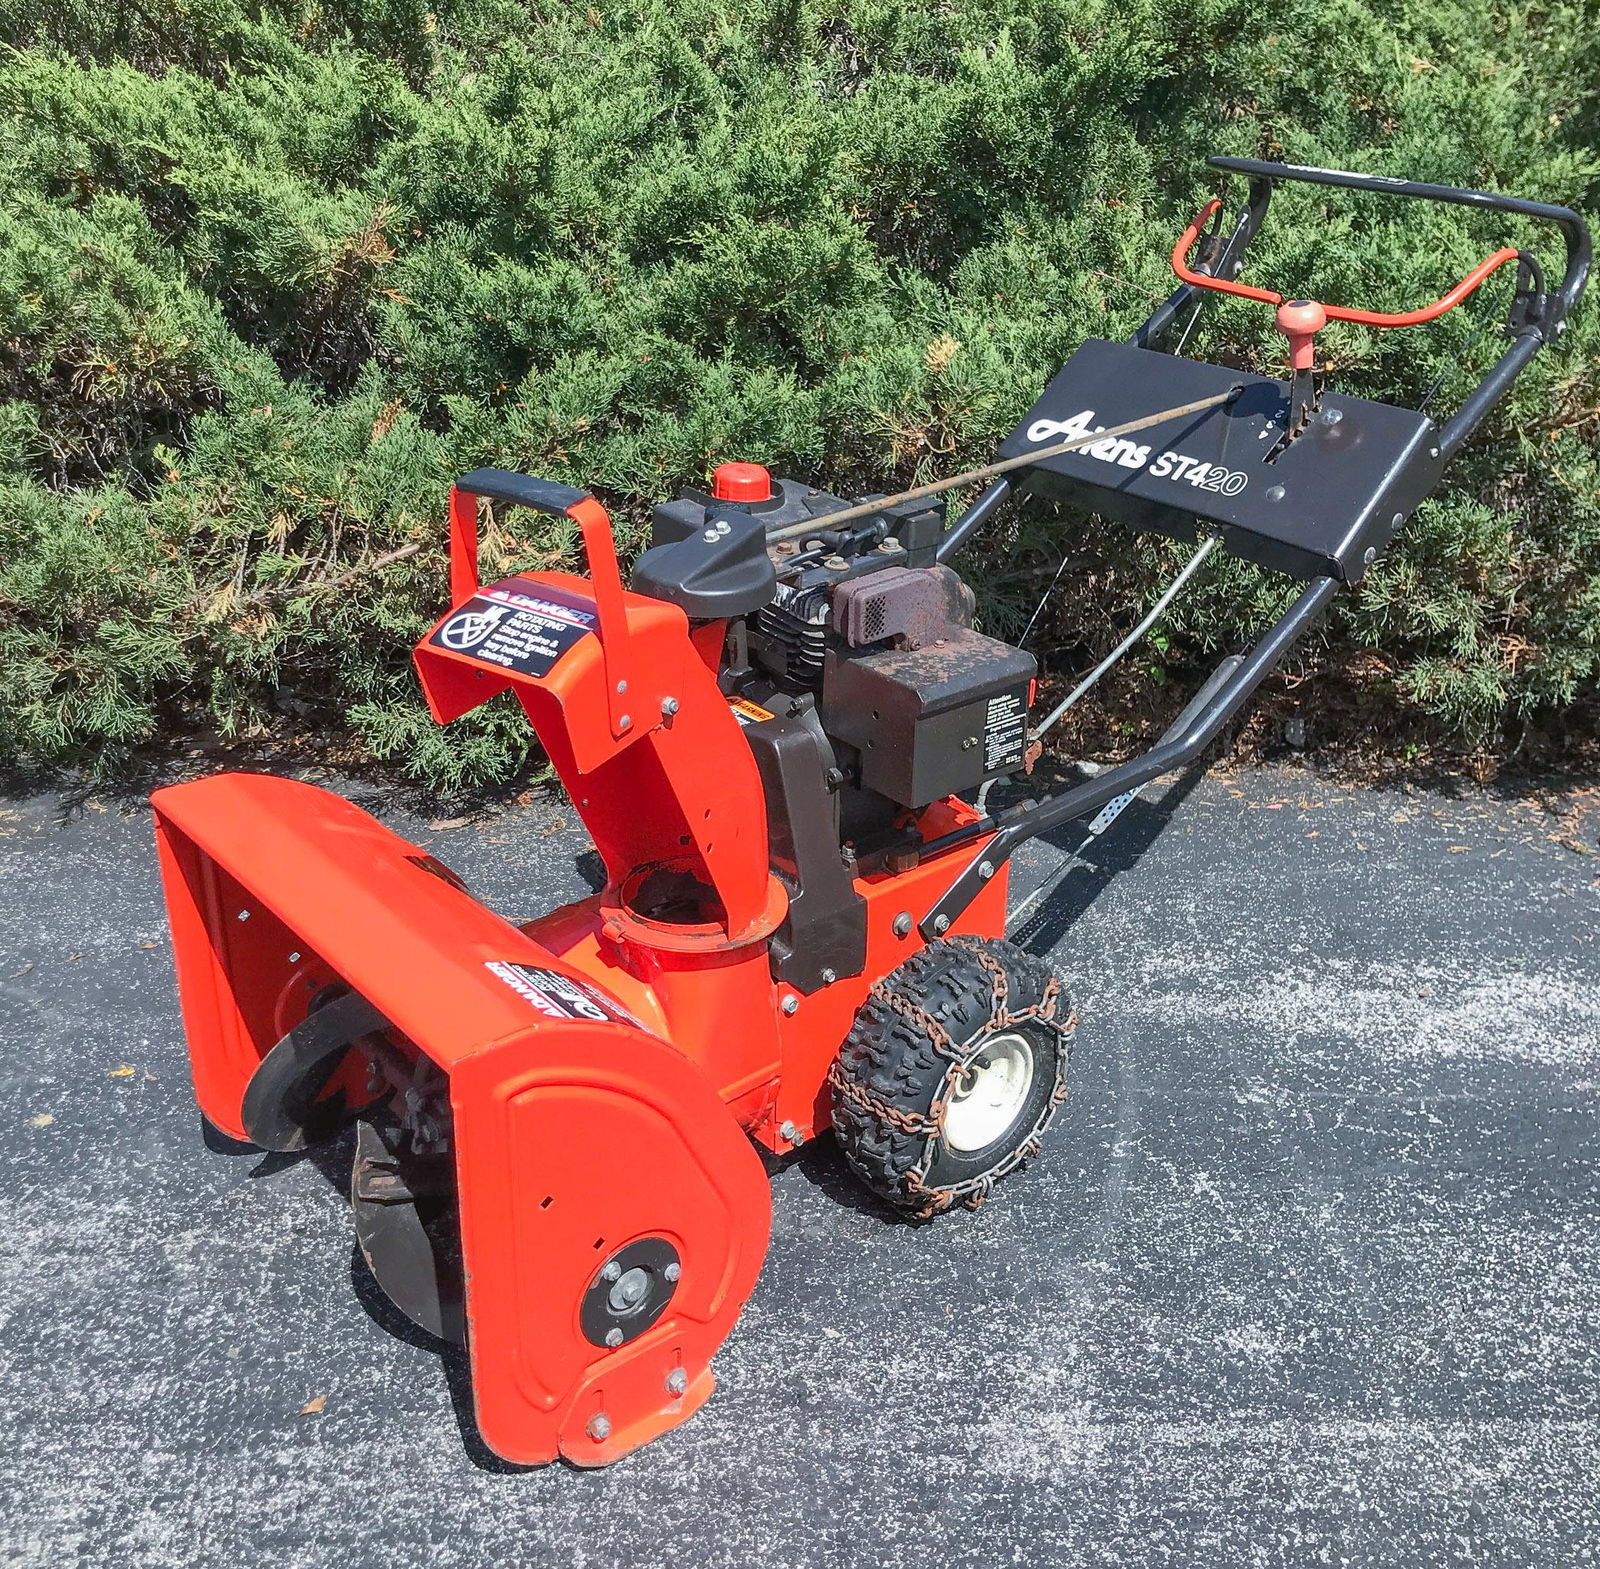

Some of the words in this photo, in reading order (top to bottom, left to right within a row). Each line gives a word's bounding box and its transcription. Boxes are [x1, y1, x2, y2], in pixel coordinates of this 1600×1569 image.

[1150, 451, 1248, 496] ST420
[511, 594, 595, 624] DANGER
[505, 619, 543, 634] PARTS
[513, 611, 567, 632] ROTATING
[491, 634, 525, 647] remove
[499, 626, 519, 638] Stop
[519, 632, 550, 647] engine
[485, 962, 546, 1008] DANGER
